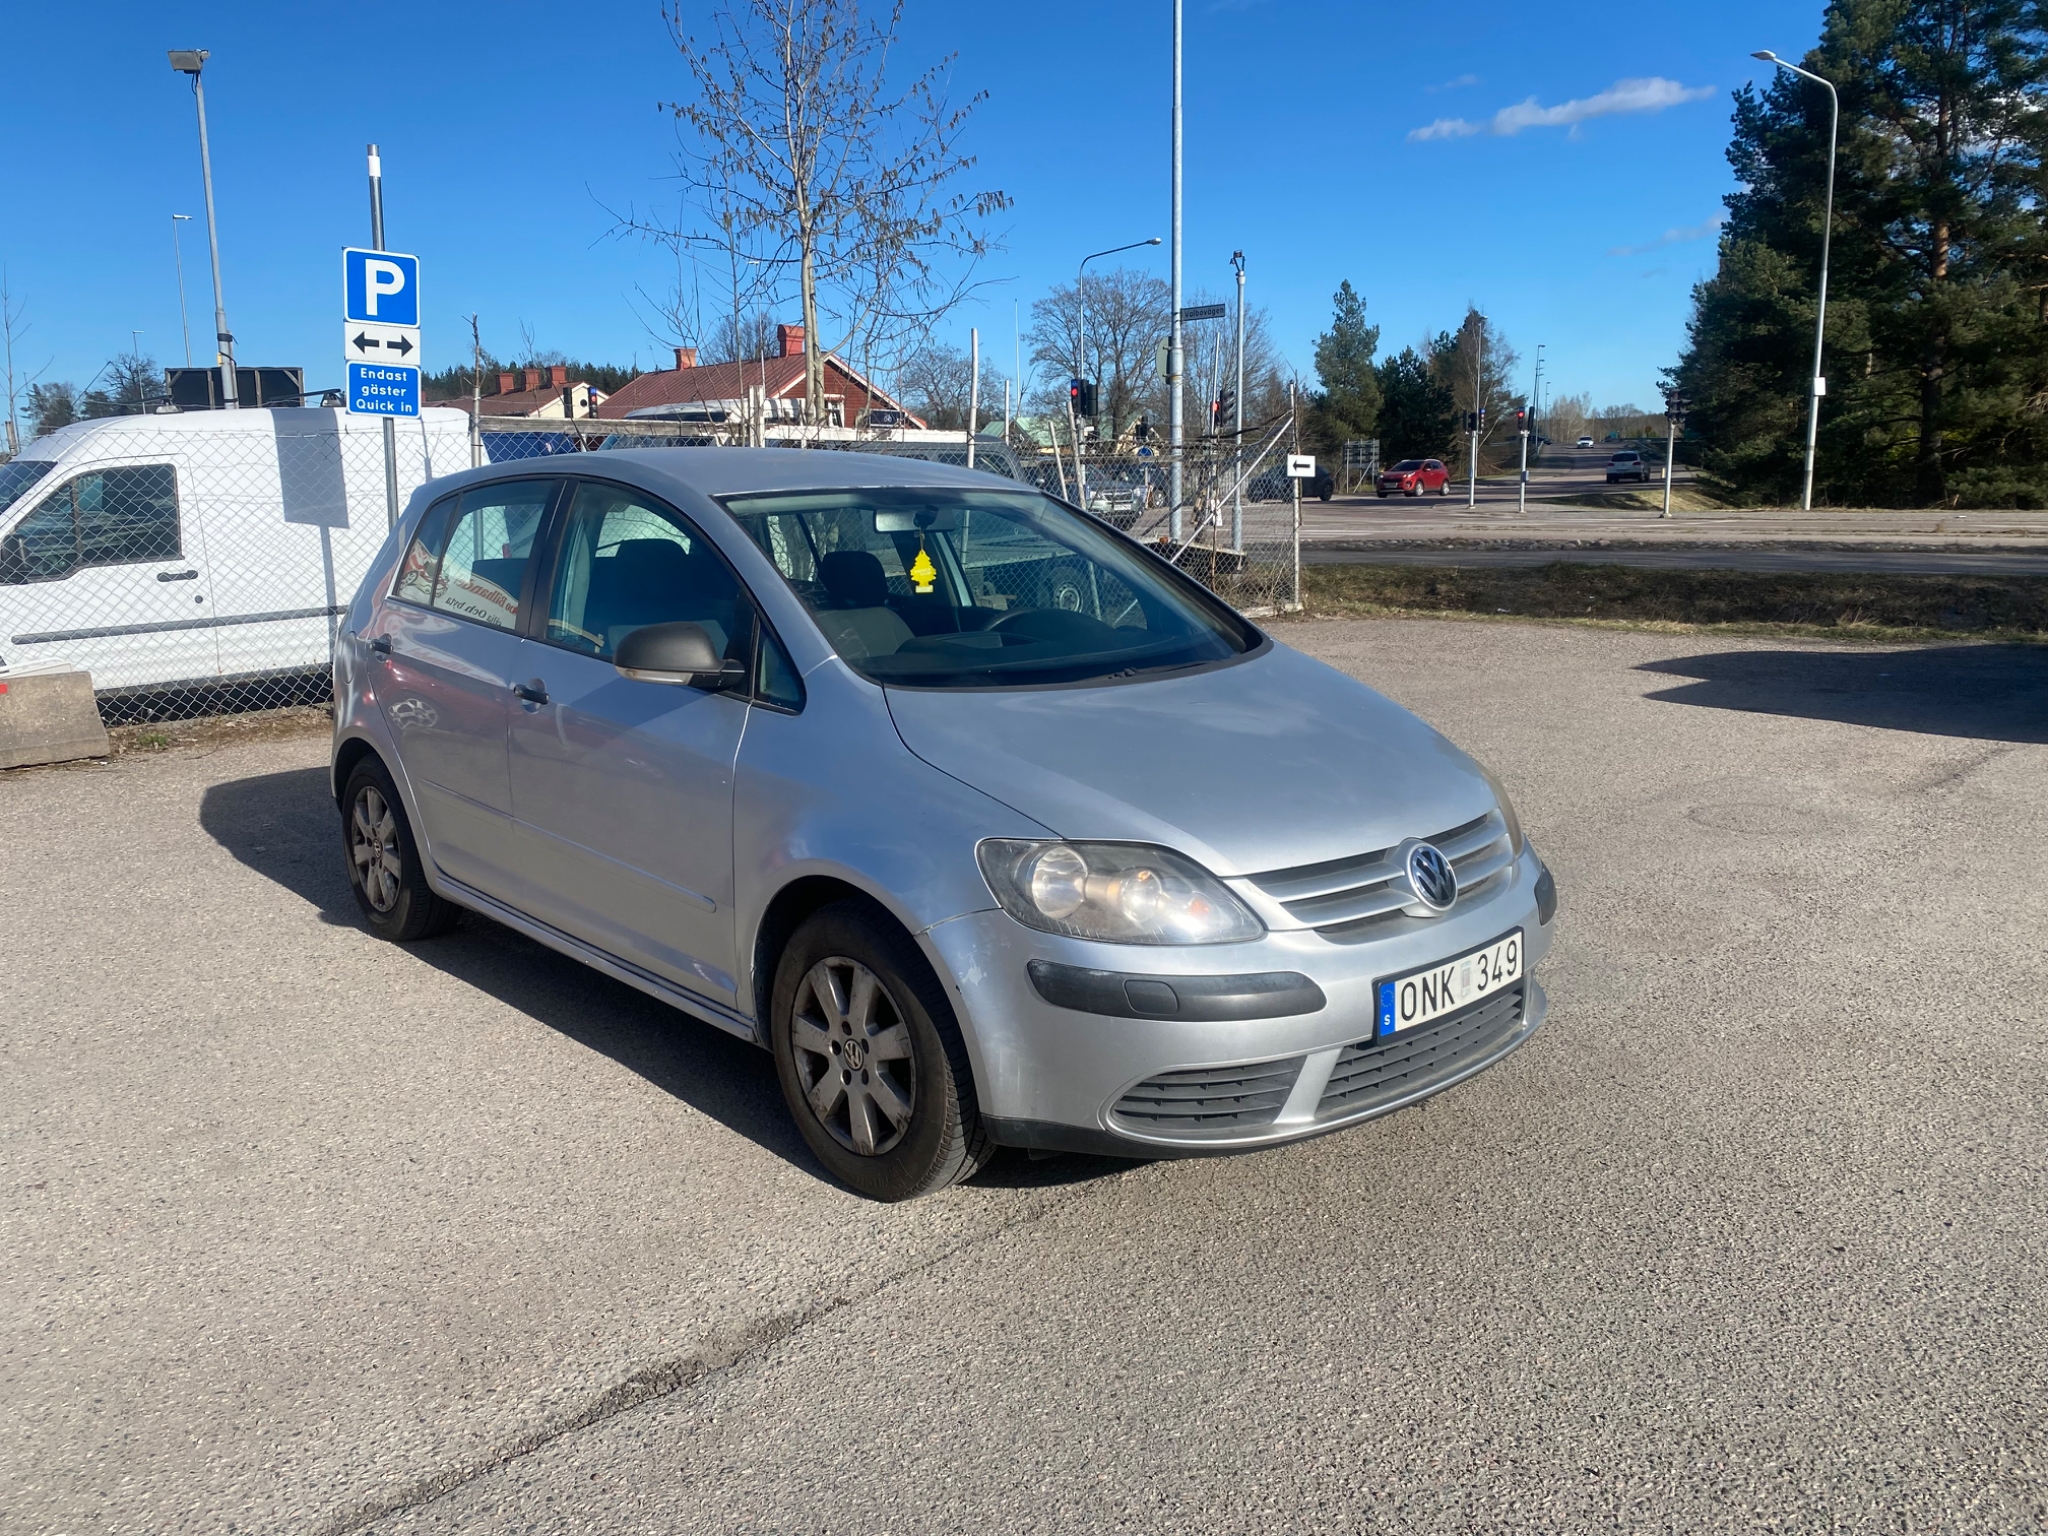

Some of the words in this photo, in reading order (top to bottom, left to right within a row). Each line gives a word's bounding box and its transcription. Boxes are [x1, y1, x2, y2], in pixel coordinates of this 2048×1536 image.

[365, 258, 405, 316] P
[360, 367, 407, 382] Endast
[361, 384, 407, 397] gäster
[356, 398, 394, 412] Quick
[400, 401, 412, 413] in
[1401, 965, 1456, 1022] ONK
[1477, 939, 1517, 992] 349
[1383, 1013, 1391, 1026] S
